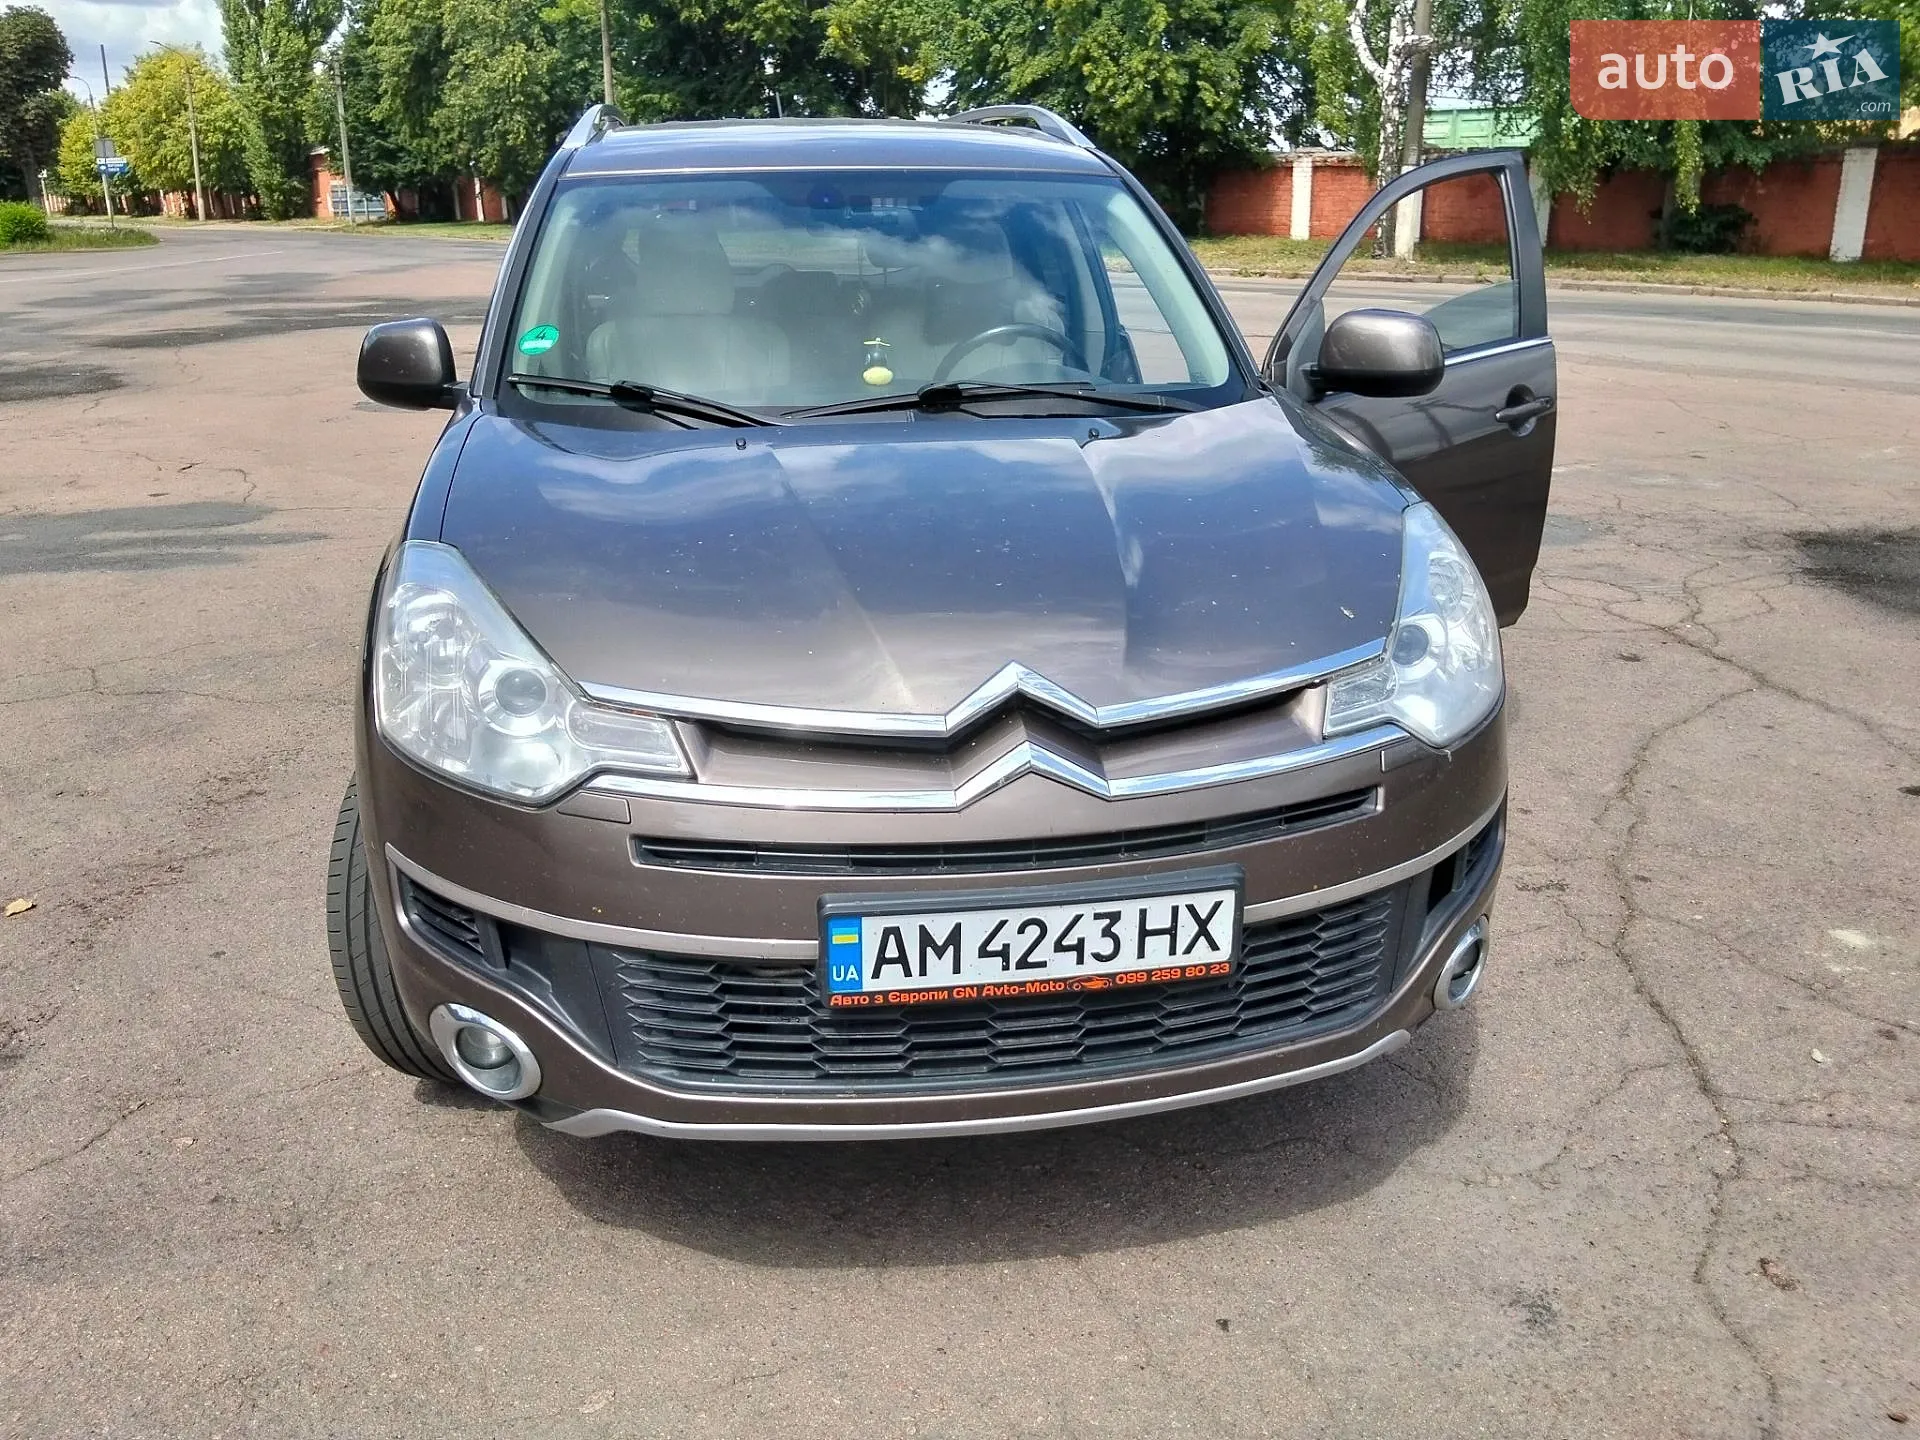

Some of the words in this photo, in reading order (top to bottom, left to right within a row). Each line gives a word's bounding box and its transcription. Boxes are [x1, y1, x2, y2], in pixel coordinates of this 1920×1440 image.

[871, 922, 962, 980] AM
[977, 910, 1121, 972] 4243
[1136, 899, 1224, 960] HX
[830, 993, 869, 1007] Авто
[888, 989, 949, 1006] Європи
[953, 987, 979, 999] GN
[982, 979, 1065, 997] Avto-Moto
[1115, 973, 1148, 985] 099
[1151, 969, 1181, 981] 259
[1184, 966, 1206, 978] 80
[1210, 963, 1230, 975] 23
[832, 965, 859, 982] UA
